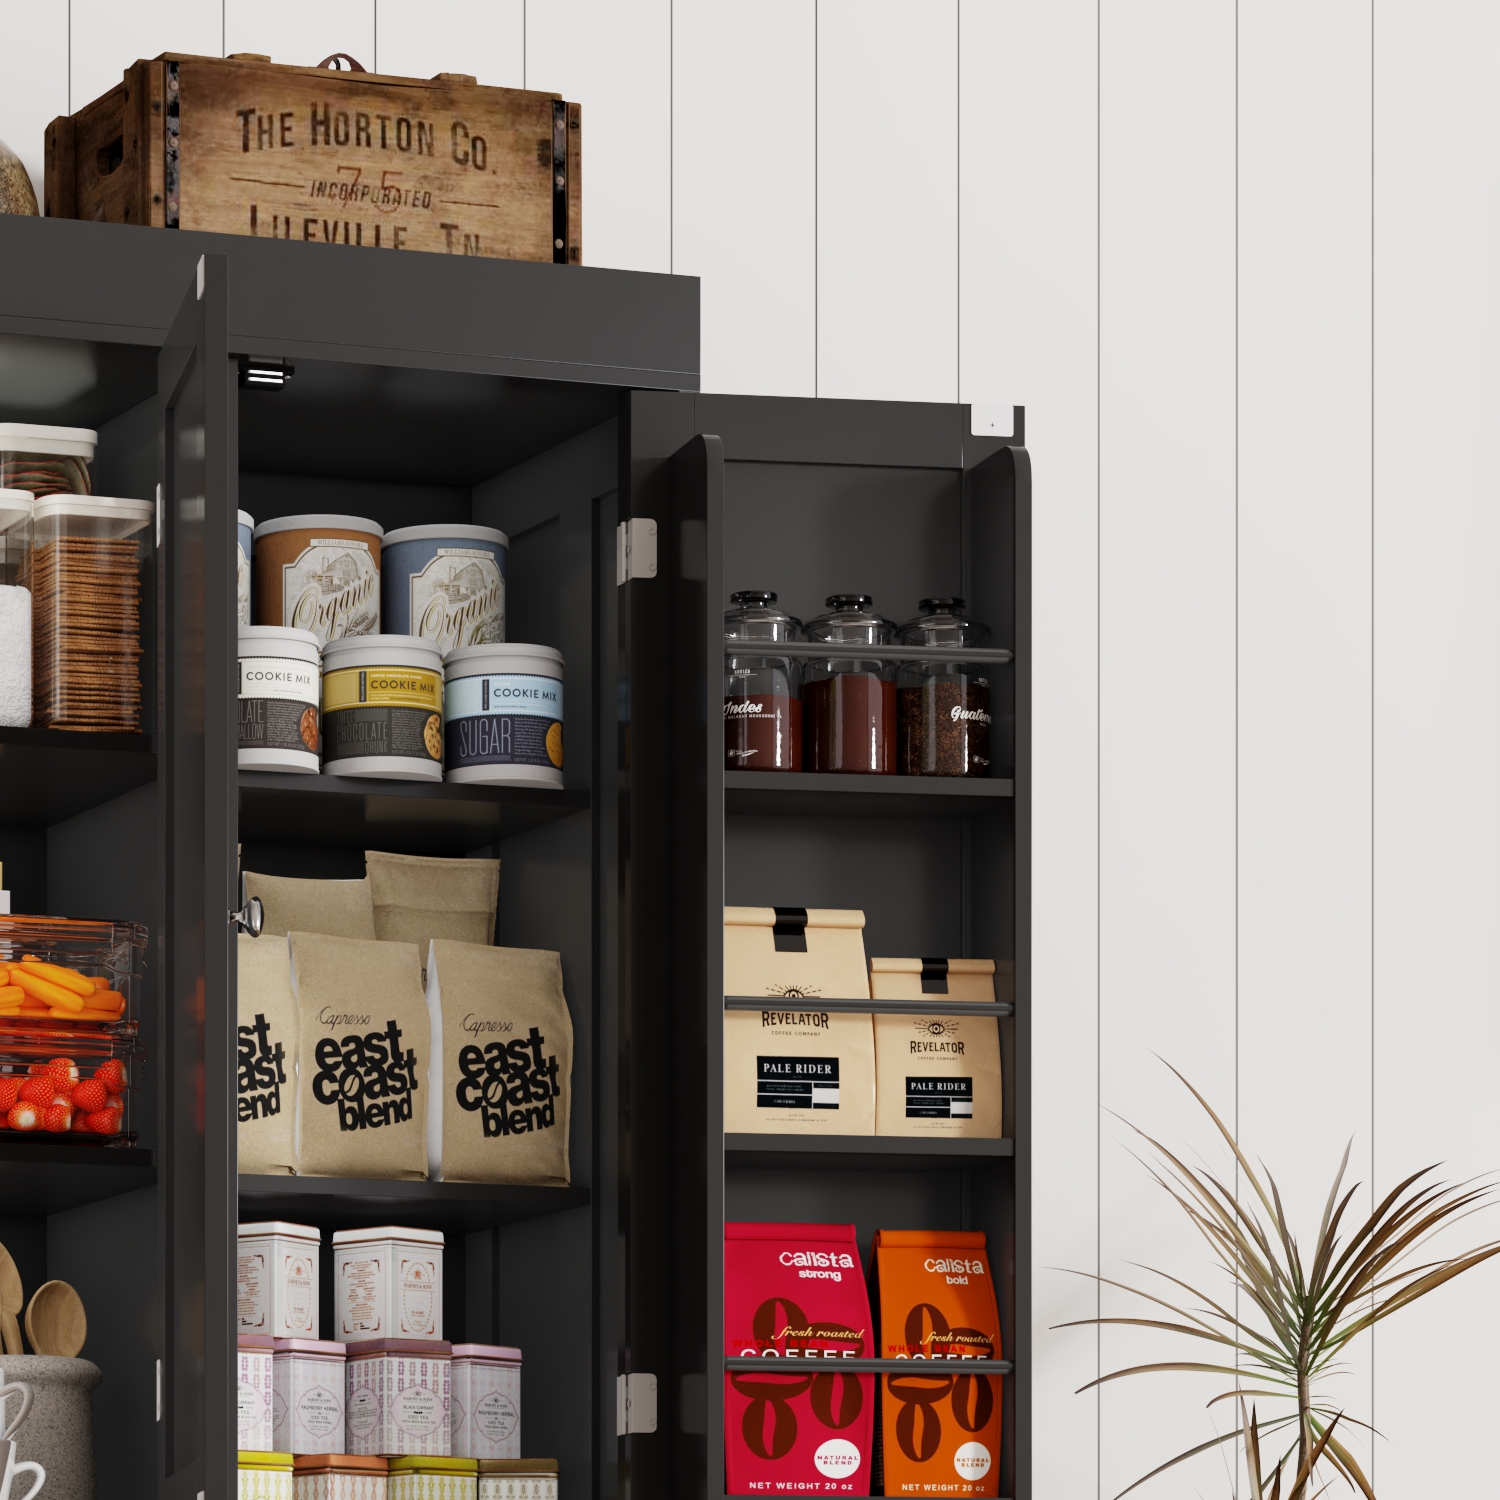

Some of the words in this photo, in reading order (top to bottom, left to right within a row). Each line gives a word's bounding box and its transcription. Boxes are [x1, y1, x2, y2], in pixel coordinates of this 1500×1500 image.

[236, 108, 294, 152] THE
[311, 102, 434, 157] HORTON
[310, 180, 432, 209] INCORPORATED
[291, 570, 375, 642] Organic
[418, 579, 501, 648] Organic
[246, 671, 292, 682] COOKIE
[295, 674, 311, 685] MIX
[370, 680, 417, 690] COOKIE
[419, 682, 435, 693] MIX
[493, 688, 539, 699] COOKIE
[542, 691, 557, 702] MIX
[459, 717, 511, 758] SUGAR
[316, 1005, 370, 1030] Capresso
[459, 1013, 514, 1037] Capresso
[762, 1011, 829, 1030] REVELATOR
[238, 1013, 271, 1058] st
[314, 1020, 402, 1072] east
[458, 1027, 546, 1079] east
[910, 1041, 965, 1055] REVELATOR
[238, 1041, 287, 1093] ast
[312, 1048, 418, 1105] coast
[763, 1063, 792, 1073] PALE
[795, 1063, 832, 1074] RIDER
[456, 1055, 561, 1112] coast
[910, 1082, 934, 1091] PALE
[937, 1082, 967, 1091] RIDER
[238, 1082, 281, 1122] end
[338, 1089, 413, 1131] blend
[481, 1096, 555, 1138] blend
[798, 1269, 842, 1282] strong
[946, 1275, 969, 1285] bold
[731, 1339, 783, 1348] WHOLE
[789, 1339, 829, 1348] BEAN
[771, 1326, 813, 1340] fresh
[816, 1329, 865, 1339] roasted
[920, 1331, 954, 1345] fresh
[954, 1334, 994, 1344] roasted
[888, 1345, 929, 1353] WHOLE
[934, 1345, 966, 1353] BEAN
[775, 1482, 821, 1490] WEIGHT
[824, 1482, 837, 1490] 20
[901, 1483, 920, 1491] NET
[923, 1483, 960, 1491] WEIGHT
